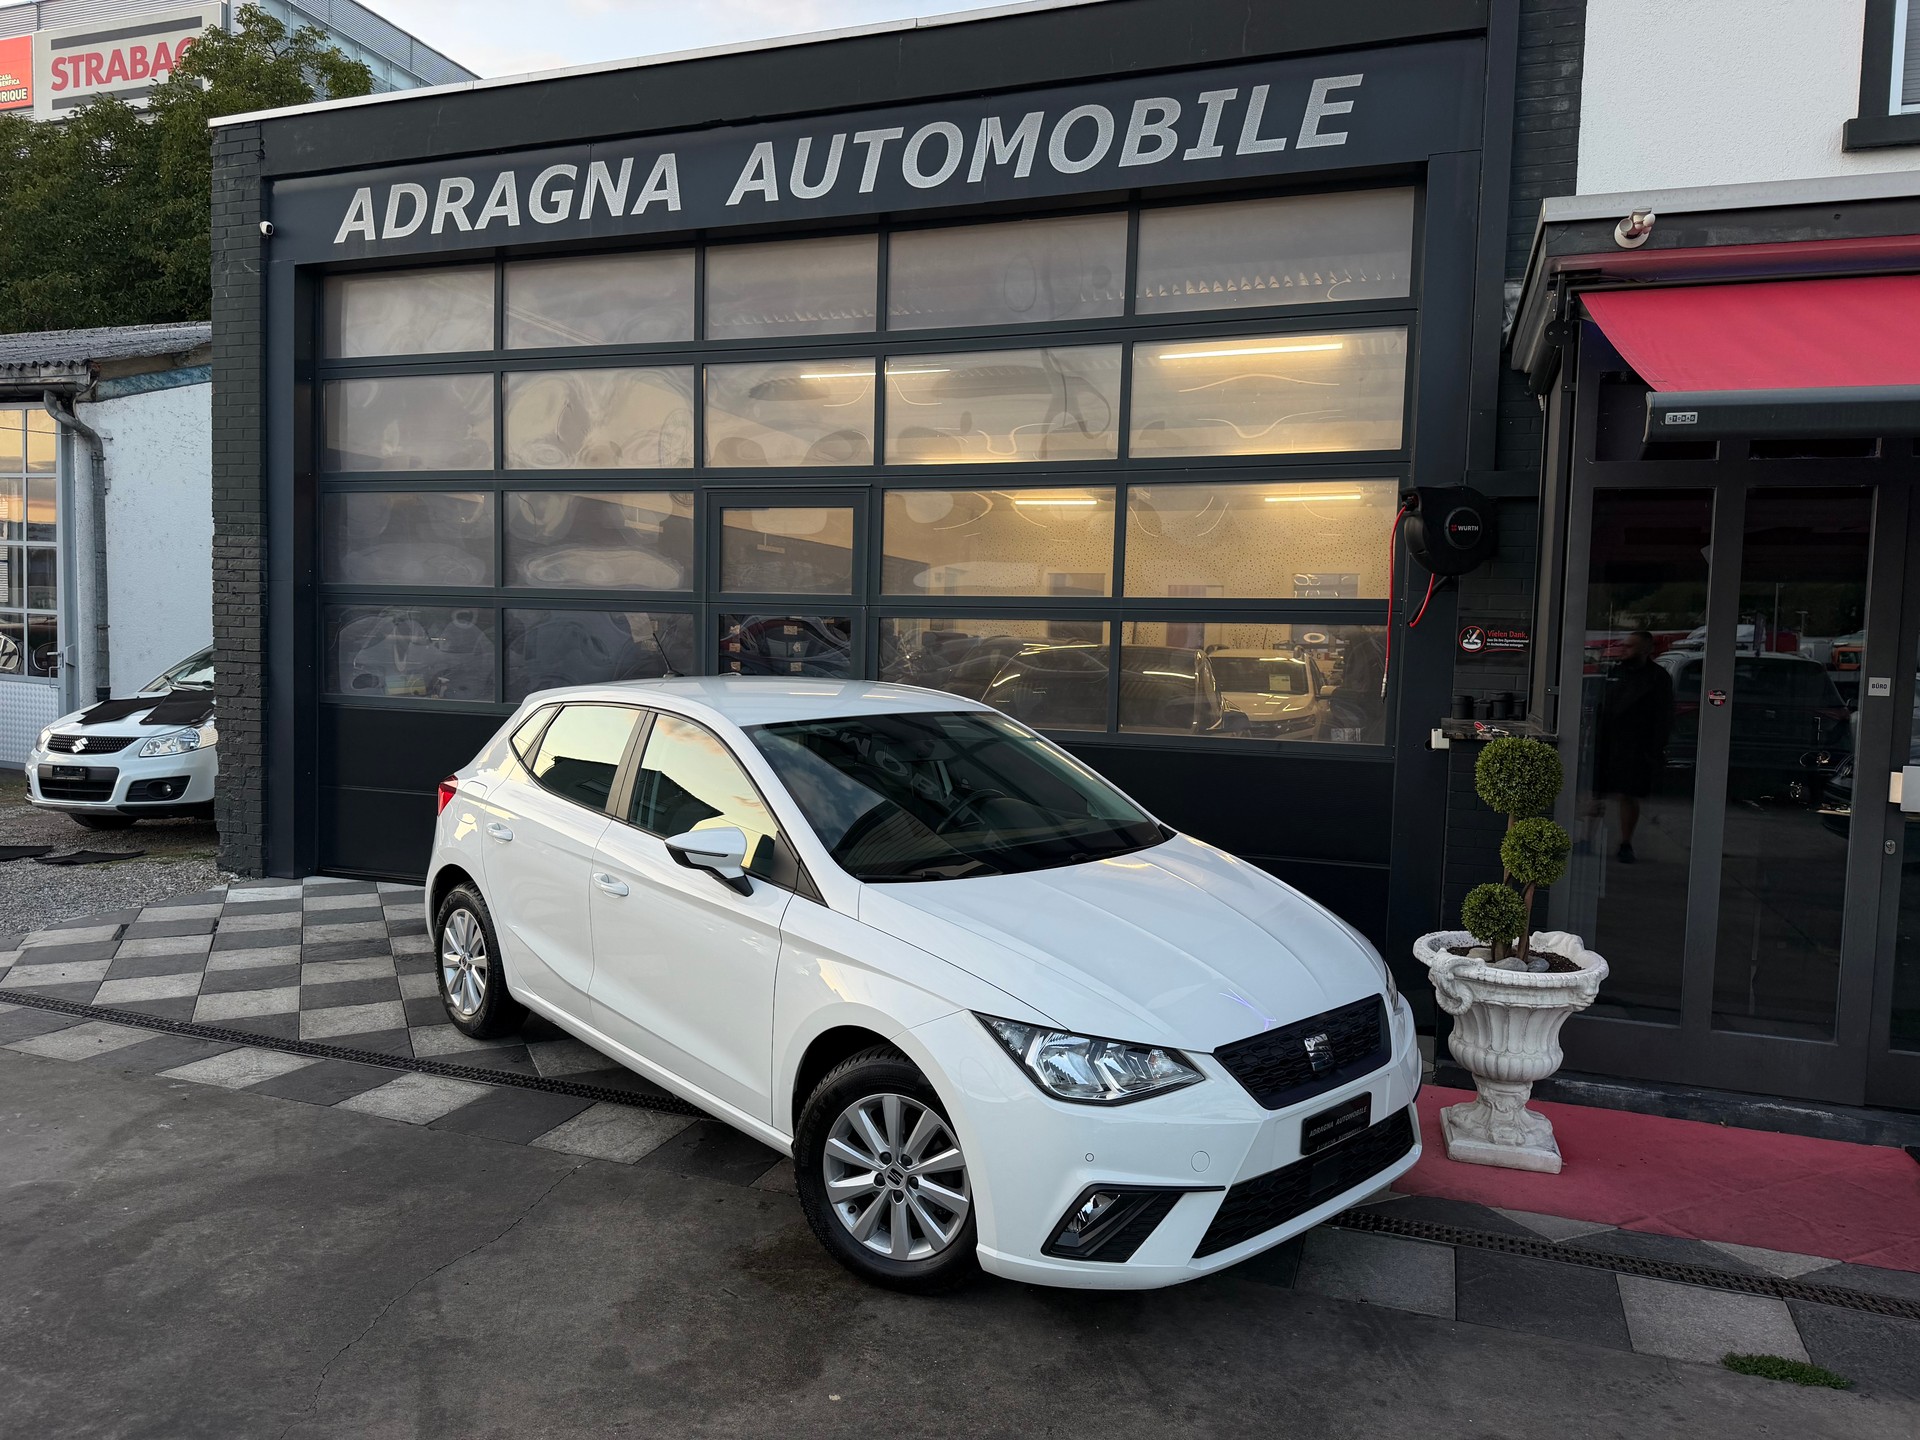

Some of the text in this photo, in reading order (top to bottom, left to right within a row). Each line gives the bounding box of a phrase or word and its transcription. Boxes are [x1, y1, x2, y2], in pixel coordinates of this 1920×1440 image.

[0, 88, 28, 102] RIQUE
[333, 73, 1364, 244] ADRAGNA AUTOMOBILE
